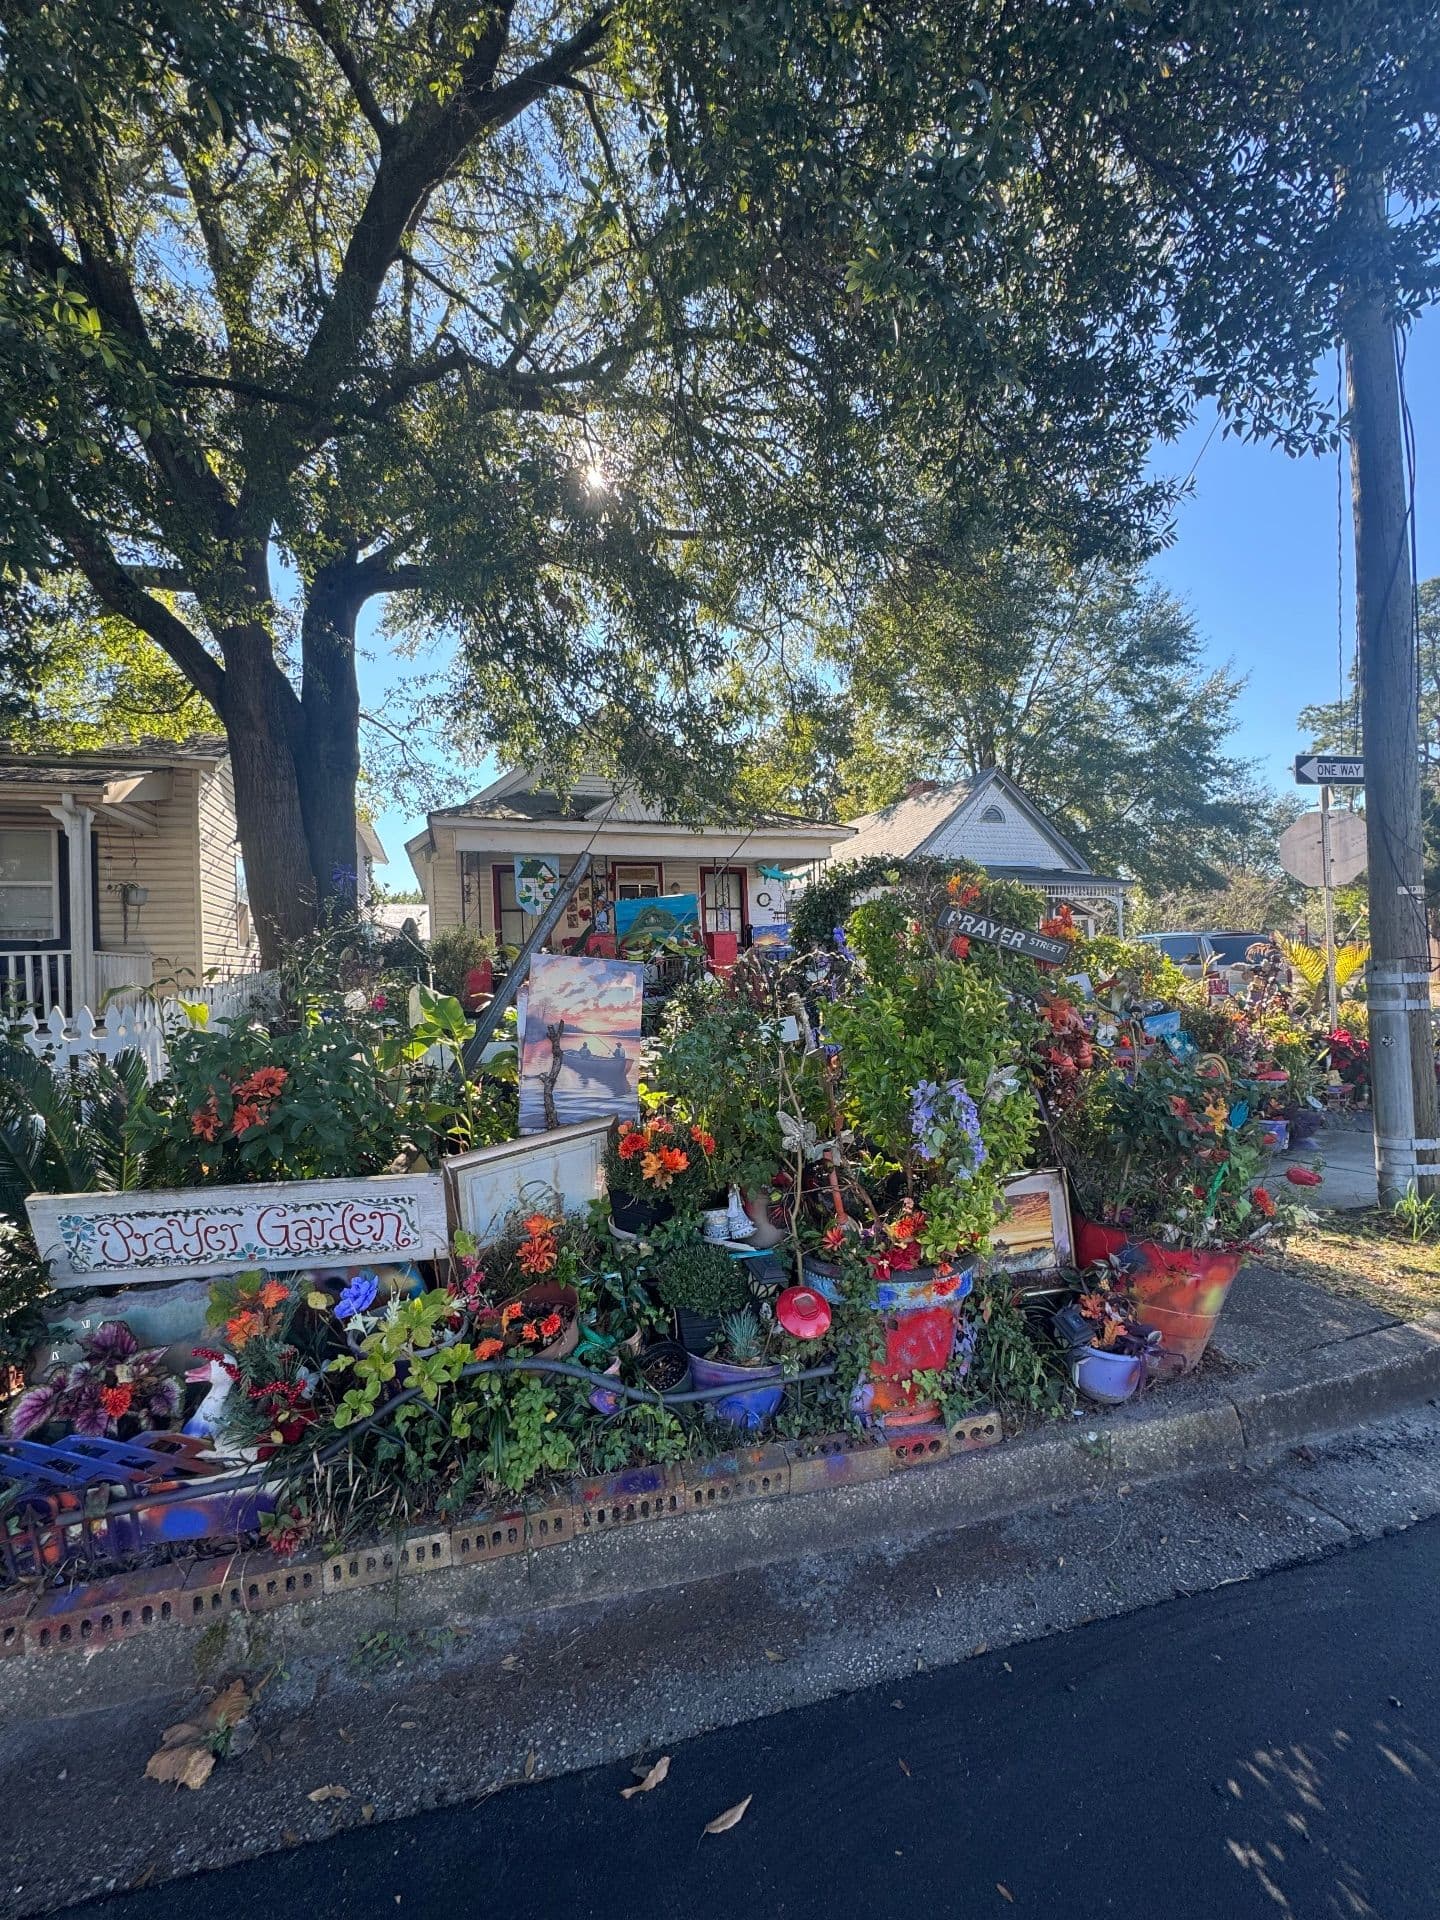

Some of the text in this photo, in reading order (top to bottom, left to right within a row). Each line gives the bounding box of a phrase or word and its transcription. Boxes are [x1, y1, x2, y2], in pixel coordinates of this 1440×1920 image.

[1317, 764, 1361, 777] ONE WAY
[946, 910, 1064, 954] PRAYER STREET
[97, 1203, 412, 1263] Prayer Garden
